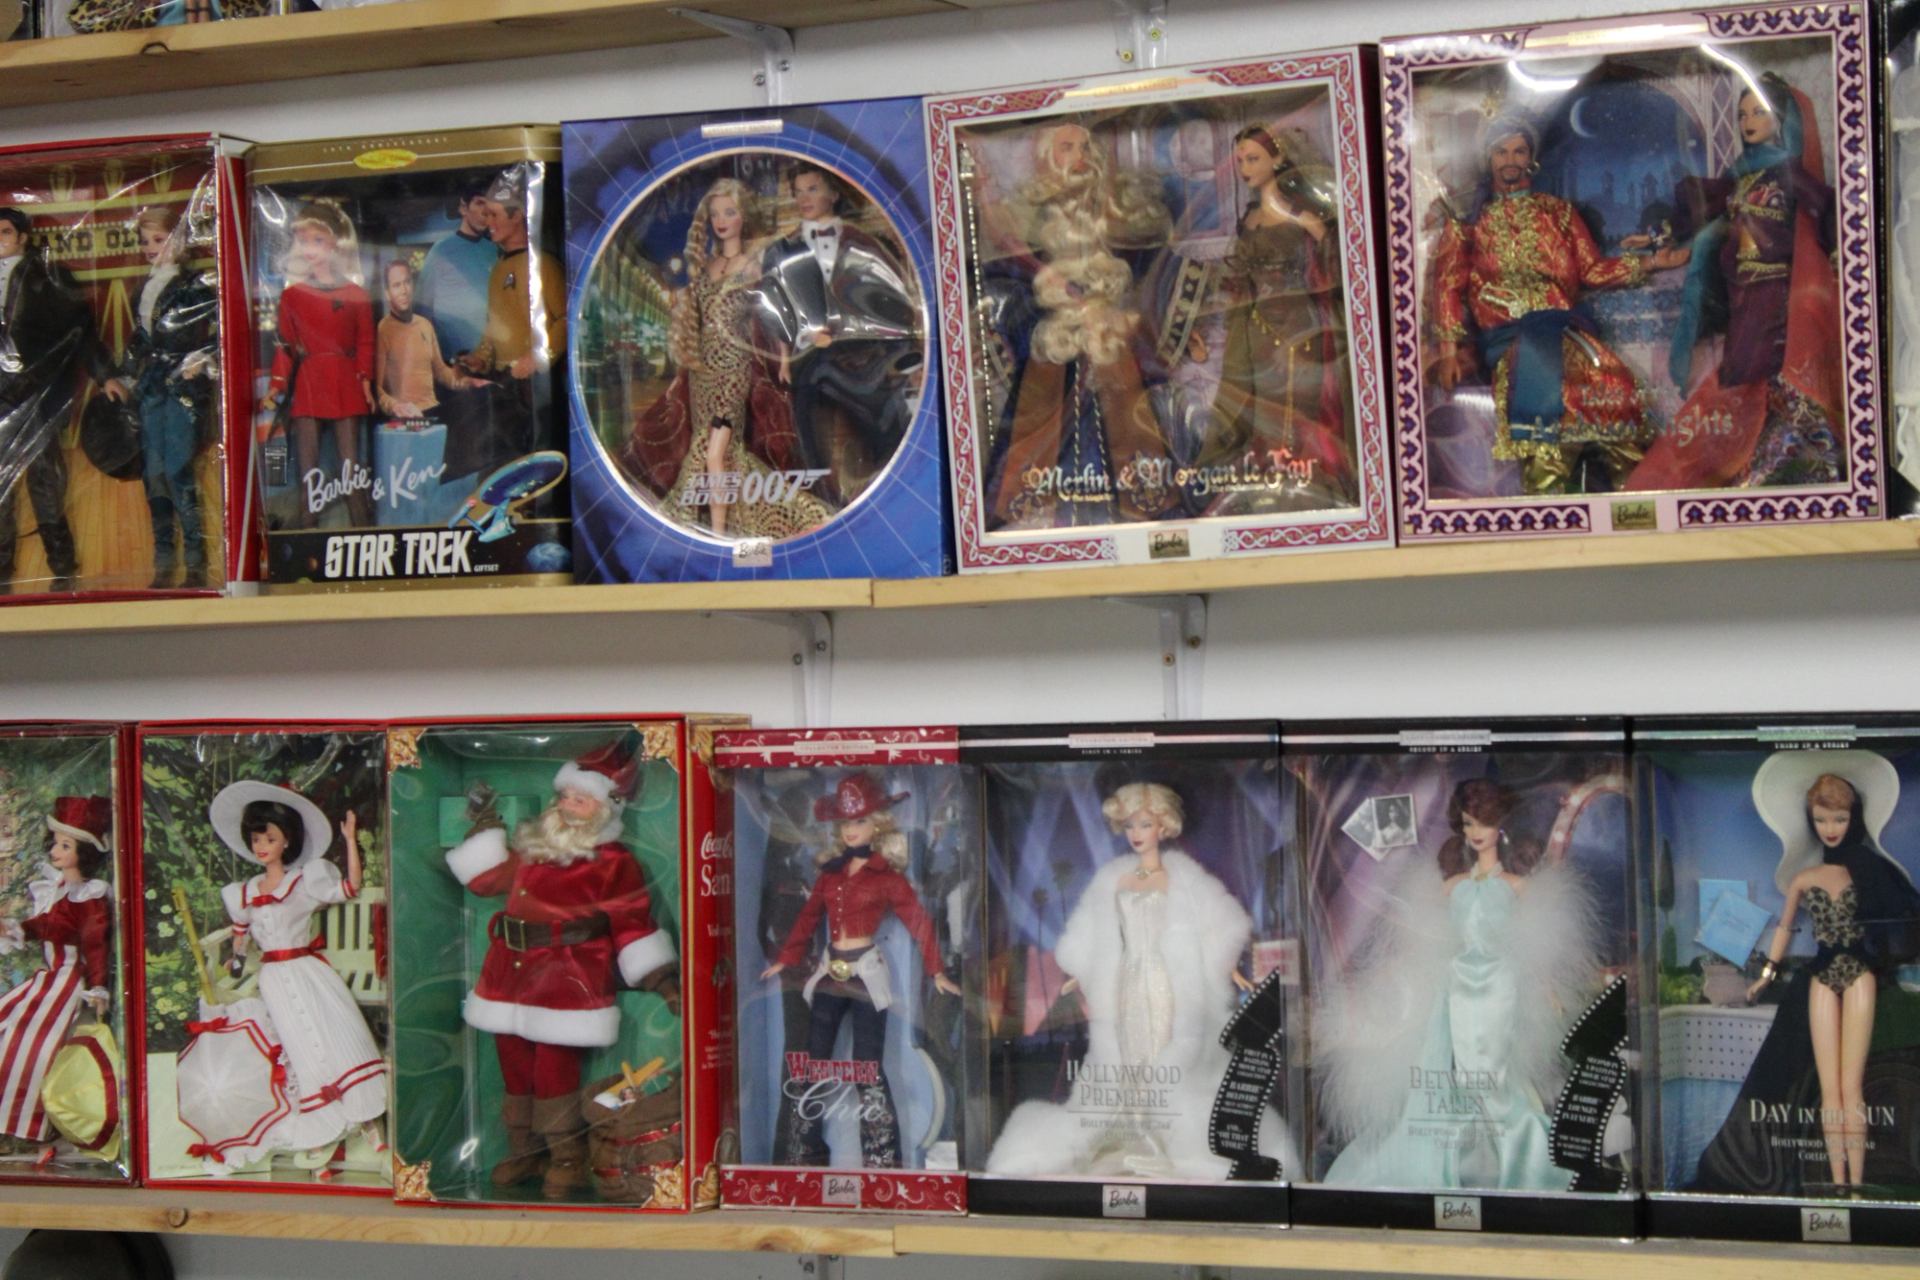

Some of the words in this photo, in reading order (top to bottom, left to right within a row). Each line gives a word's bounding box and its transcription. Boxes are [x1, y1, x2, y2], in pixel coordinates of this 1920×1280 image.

[303, 458, 372, 513] Barbie
[372, 477, 385, 501] &
[389, 457, 447, 508] Ken
[686, 471, 743, 489] JAMES
[1022, 463, 1111, 501] Merlin
[1131, 455, 1238, 496] Morgan
[1264, 447, 1318, 489] Fay
[679, 489, 739, 506] BOND
[741, 469, 832, 505] 007
[1617, 503, 1650, 524] Barbie
[324, 533, 395, 578] STAR
[402, 530, 473, 576] TREK
[785, 1052, 879, 1084] WESTERN
[1066, 1060, 1181, 1084] HOLLYWOOD
[1409, 1066, 1500, 1090] BETWEEN
[783, 1076, 883, 1121] Chic
[1080, 1084, 1169, 1108] PREMIERE
[1425, 1091, 1485, 1115] TAKES
[1750, 1098, 1792, 1124] DAY
[1798, 1107, 1815, 1124] IN
[1856, 1101, 1895, 1127] SUN
[1771, 1135, 1823, 1148] HOLLYWOOD
[828, 1178, 856, 1196] Barbie
[1109, 1190, 1141, 1208] Barbie
[1442, 1202, 1475, 1219] Barbie
[1809, 1212, 1845, 1231] Barbie
